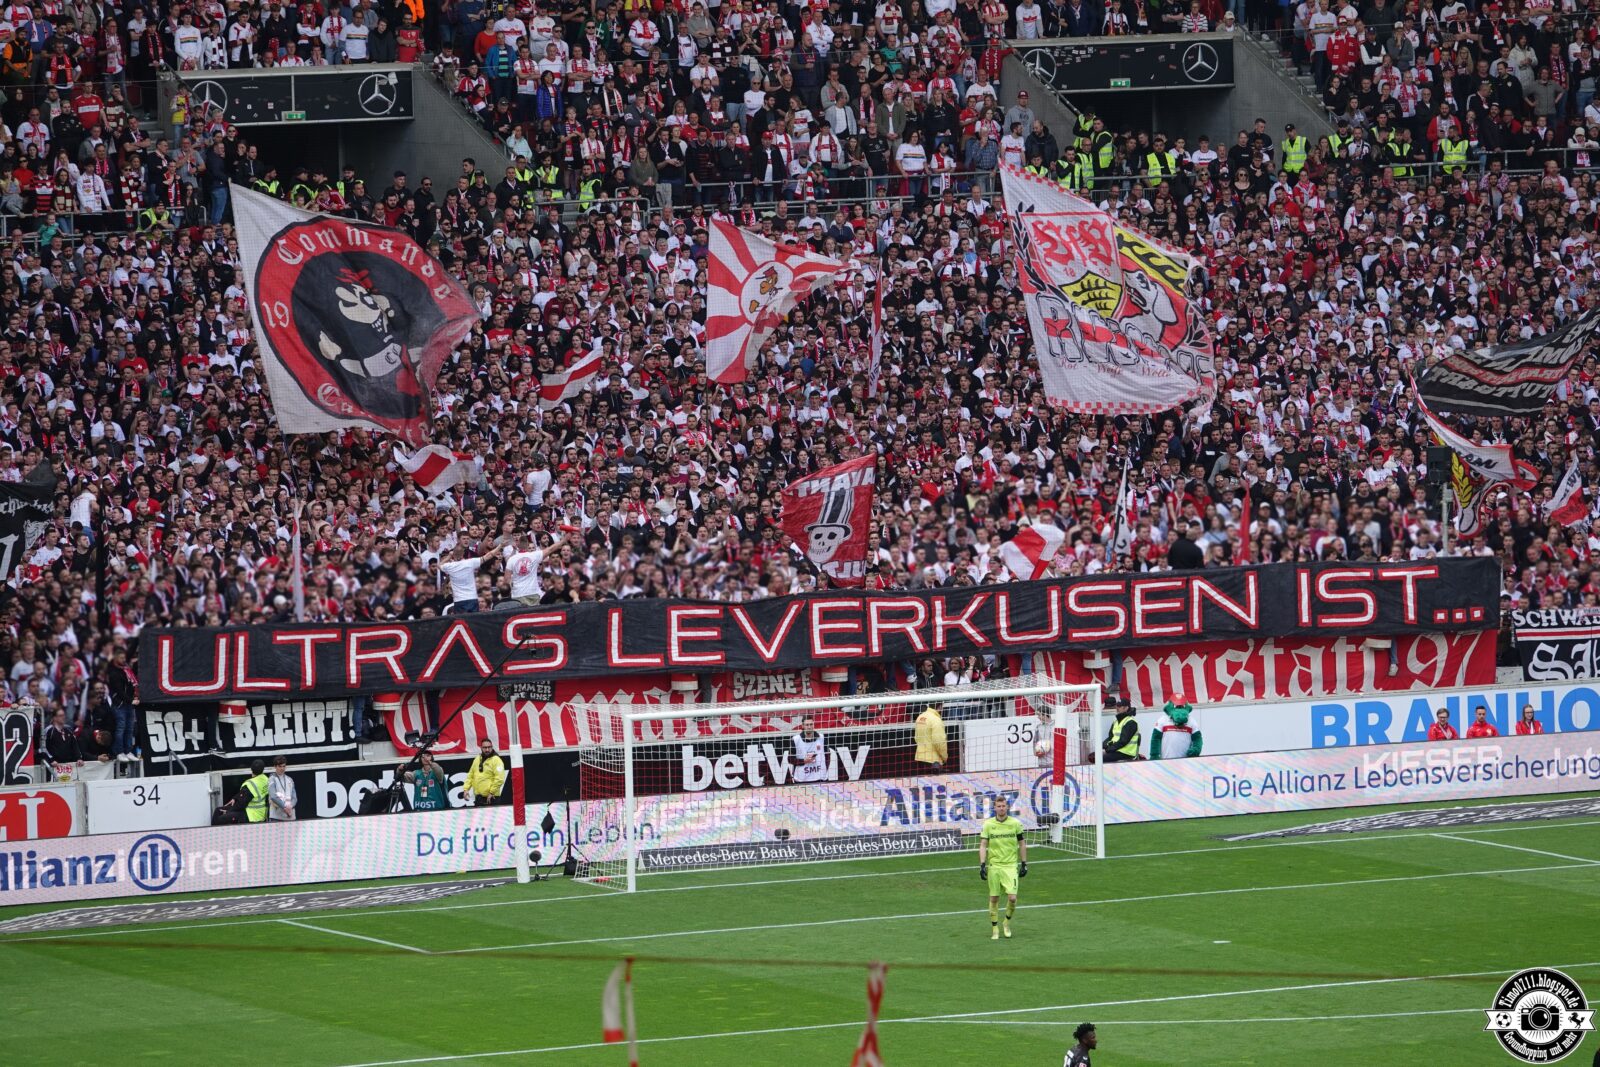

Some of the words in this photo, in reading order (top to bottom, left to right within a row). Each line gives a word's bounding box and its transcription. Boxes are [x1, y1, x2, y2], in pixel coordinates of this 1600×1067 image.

[261, 300, 291, 329] 19
[158, 611, 569, 695] ULTRAS
[607, 570, 1259, 667] LEVERKUSEN
[1298, 565, 1485, 627] IST...
[1407, 631, 1483, 688] 97
[733, 671, 797, 700] SZENE
[1007, 722, 1034, 745] 35
[803, 765, 821, 774] SMF
[132, 784, 161, 806] 34
[1212, 774, 1252, 799] Die
[1259, 769, 1346, 796] Allianz
[414, 800, 436, 809] HOST
[417, 832, 453, 857] Da
[462, 827, 500, 854] für
[810, 836, 916, 857] Mercedes-Benz
[921, 832, 958, 849] Bank
[648, 848, 757, 869] Mercedes-Benz
[761, 845, 799, 860] Bank
